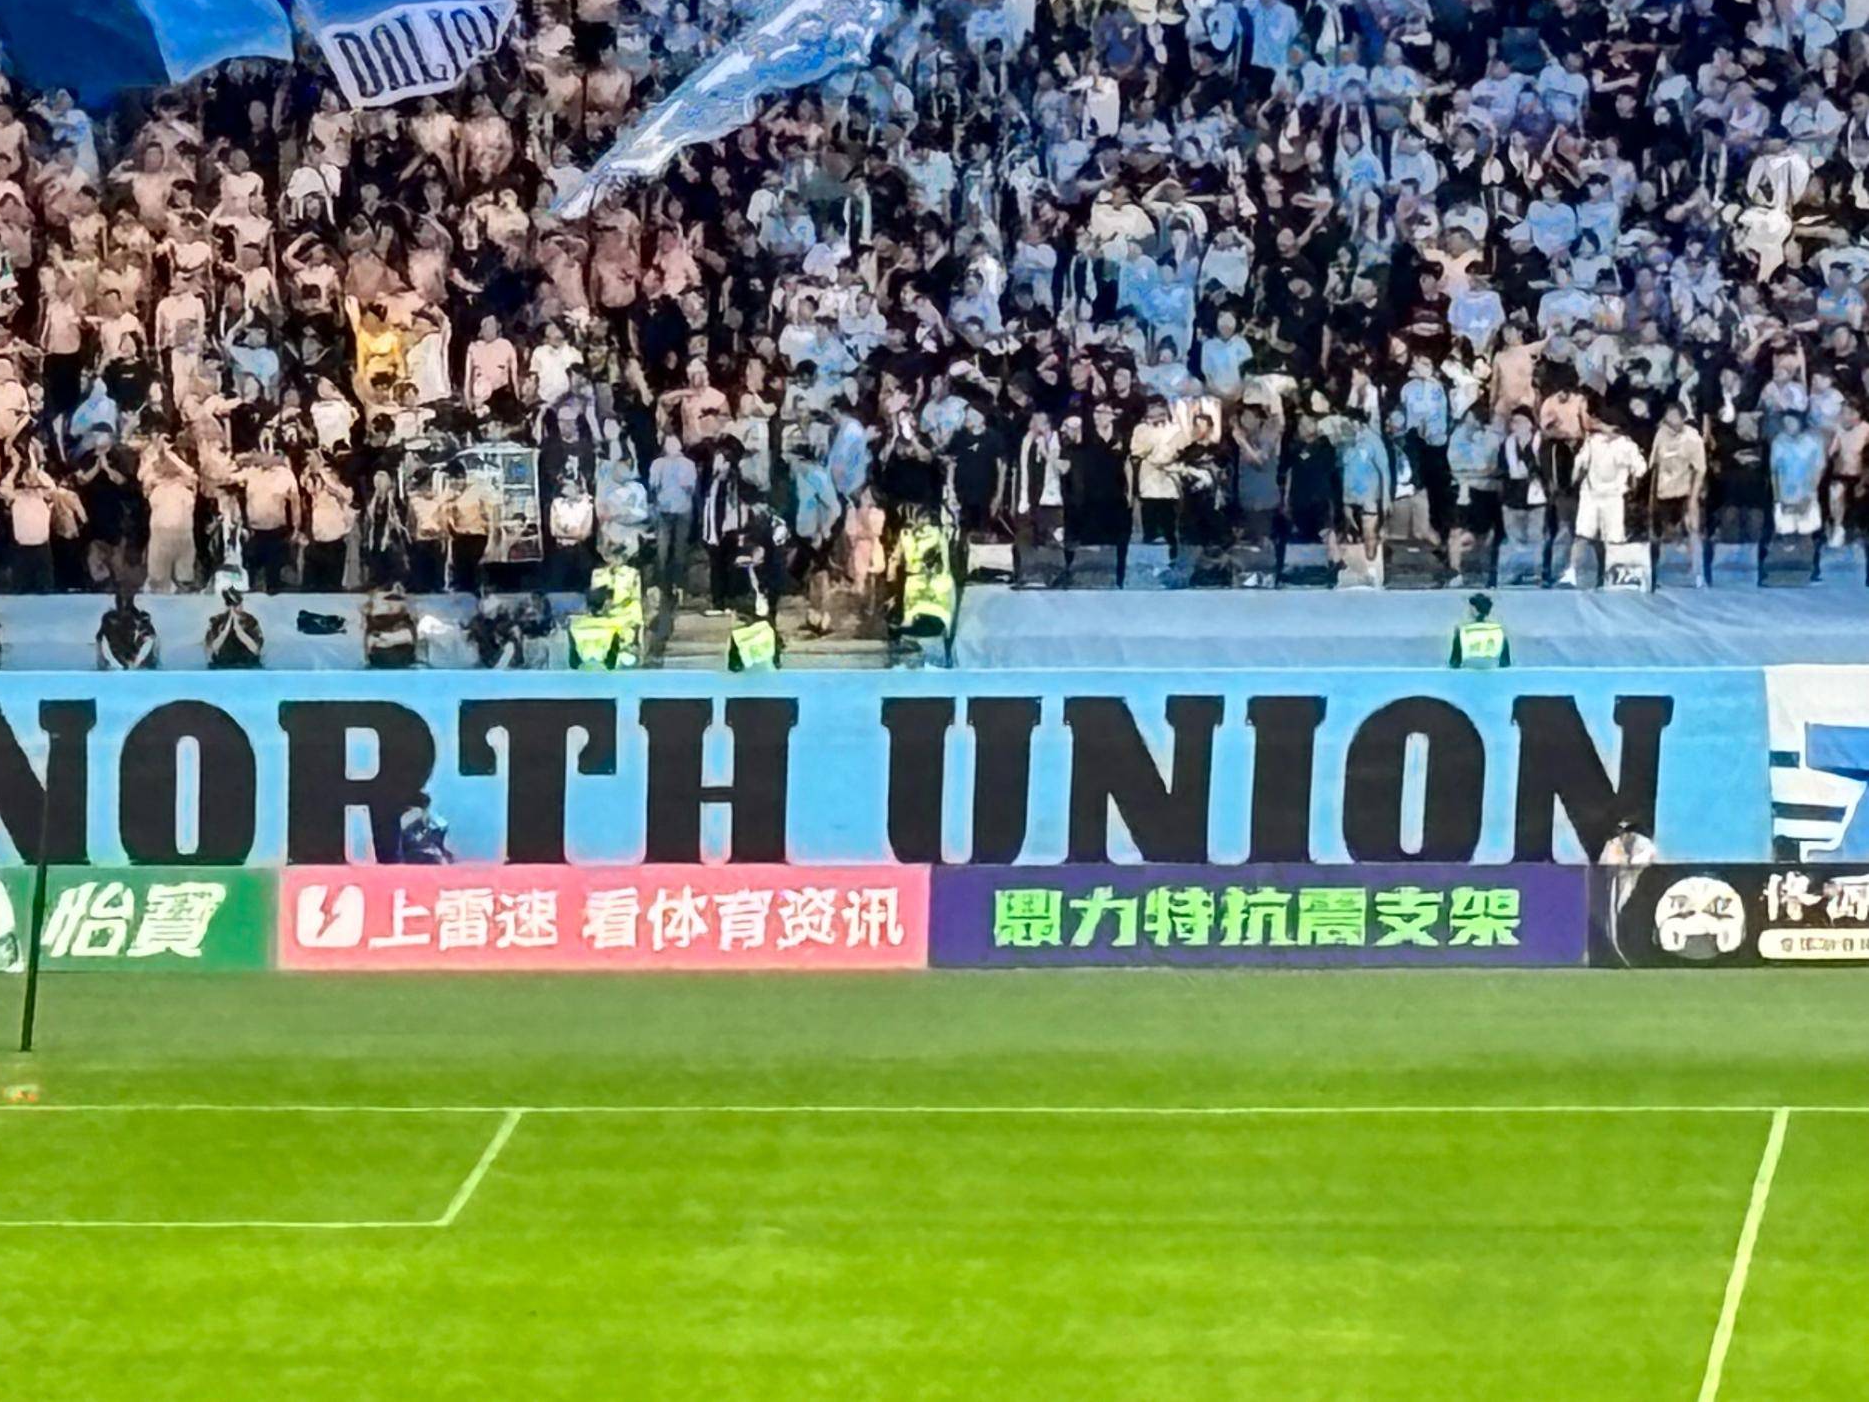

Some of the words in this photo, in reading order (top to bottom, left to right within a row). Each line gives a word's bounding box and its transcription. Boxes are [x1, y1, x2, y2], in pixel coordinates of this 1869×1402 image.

[881, 696, 1675, 864] UNION
[40, 881, 227, 958] 怡寶
[368, 886, 560, 951] 上雷速
[581, 884, 904, 951] 看体育资讯
